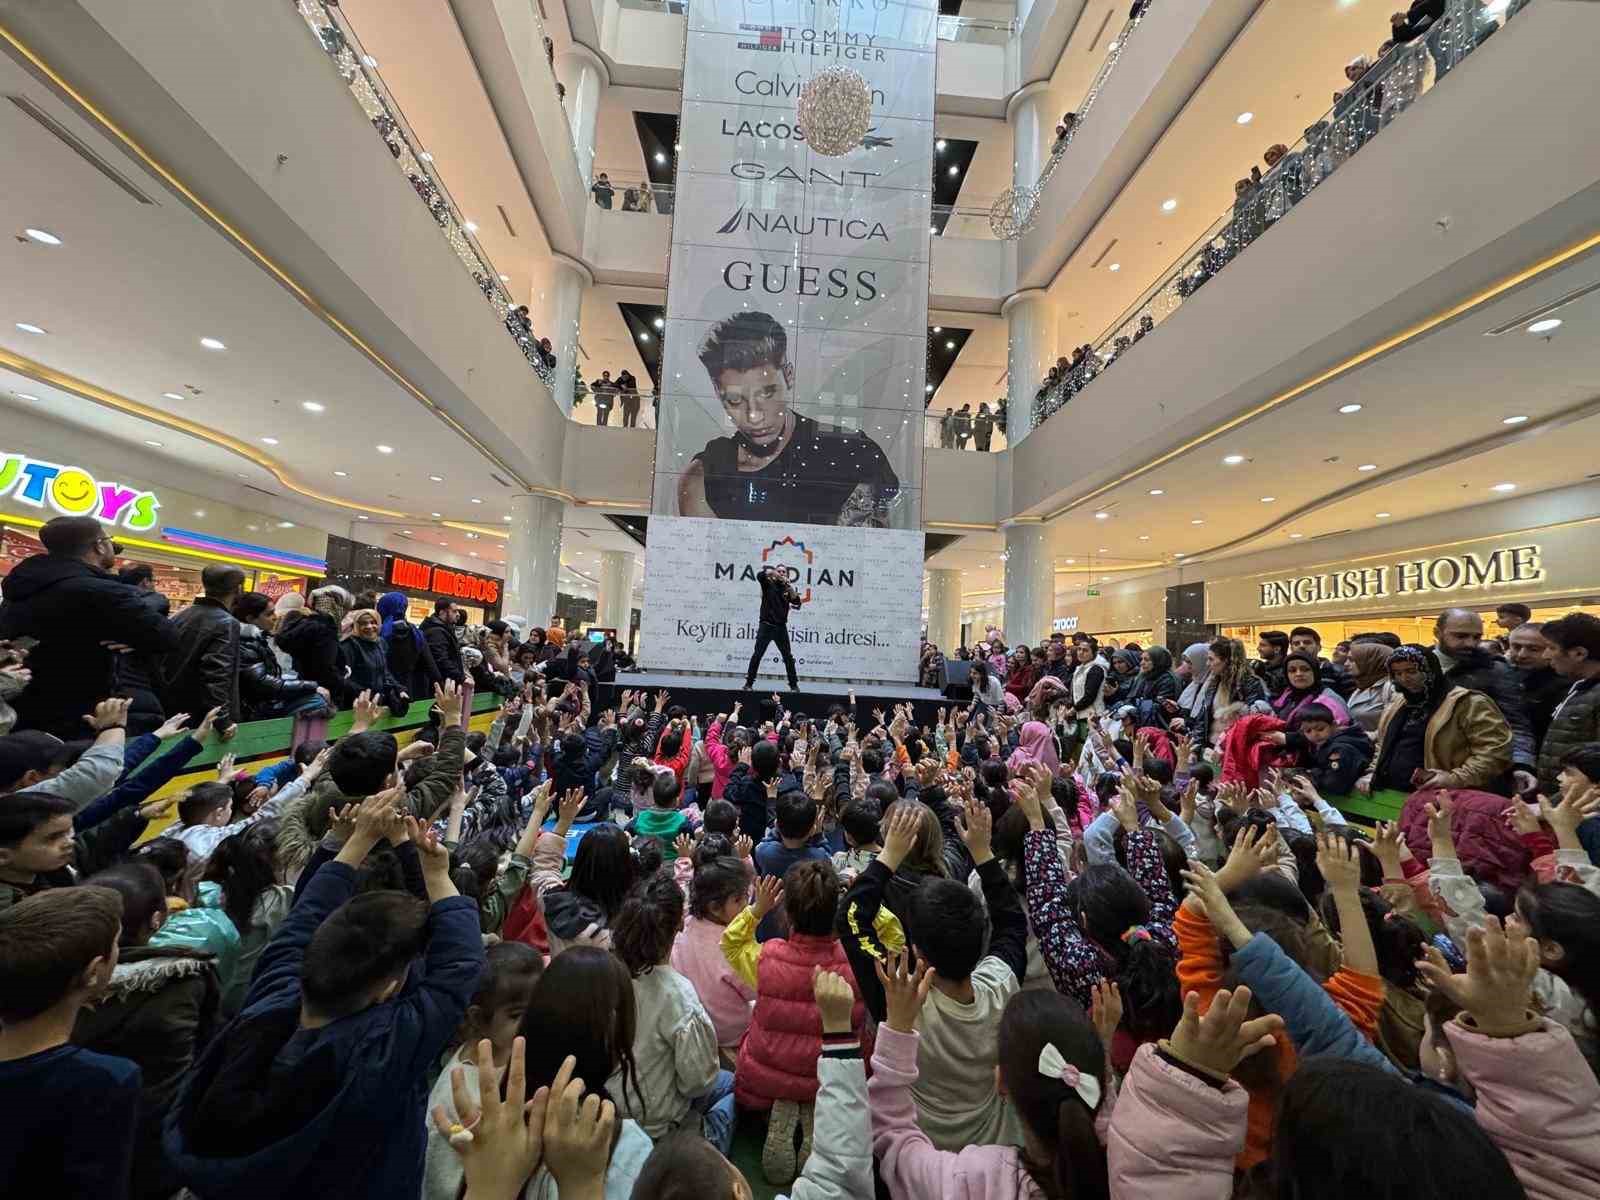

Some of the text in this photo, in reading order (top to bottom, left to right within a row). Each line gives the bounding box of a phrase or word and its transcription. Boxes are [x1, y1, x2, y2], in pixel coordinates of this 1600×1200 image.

[785, 26, 878, 47] TOMMY
[782, 42, 887, 63] HILFIGER
[735, 70, 801, 98] Calvi
[721, 119, 806, 142] LACOS
[730, 162, 882, 188] GANT
[746, 211, 889, 242] NAUTICA
[722, 260, 877, 301] GUESS
[432, 567, 498, 603] MIGROS
[1260, 545, 1546, 608] ENGLISH HOME
[676, 618, 891, 649] Keyifli alıişin adresi...
